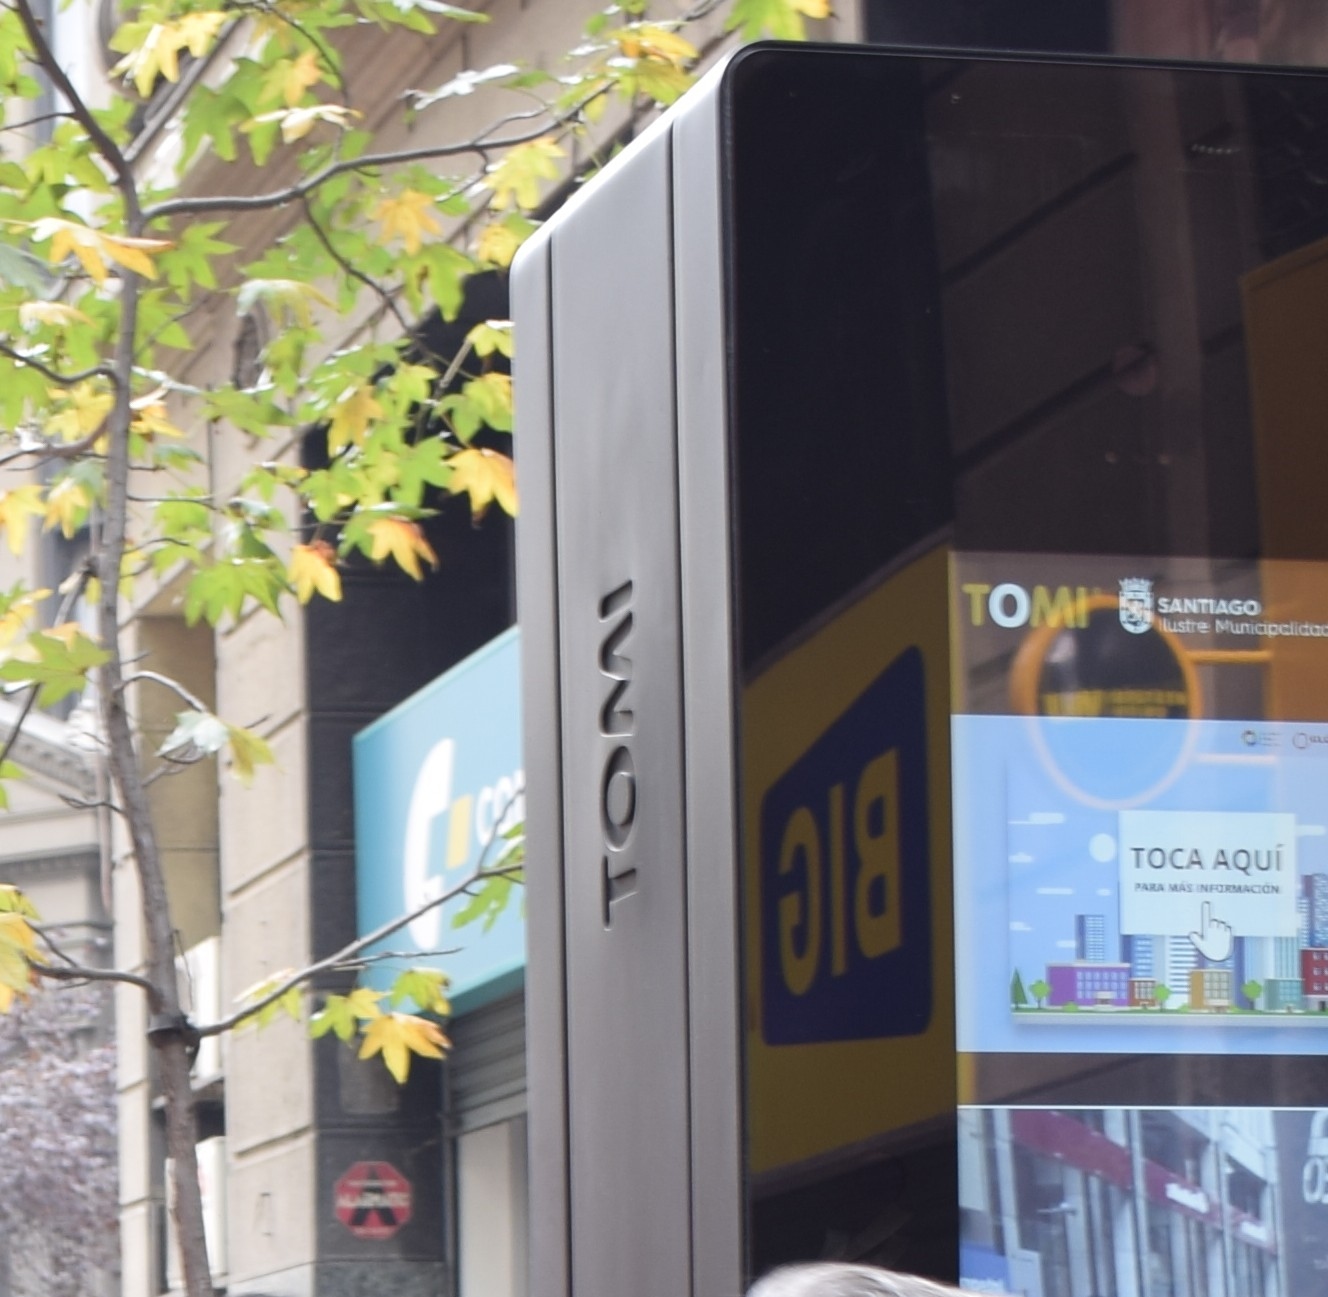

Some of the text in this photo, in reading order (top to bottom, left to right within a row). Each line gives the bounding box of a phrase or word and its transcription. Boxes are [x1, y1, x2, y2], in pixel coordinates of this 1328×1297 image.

[961, 583, 1090, 629] TOMI
[1157, 597, 1262, 617] SANTIAGO
[598, 579, 637, 931] TOMI
[1130, 843, 1285, 876] TOCA AQUÍ
[1134, 880, 1280, 895] PARA MÁS INFORMACIÓN
